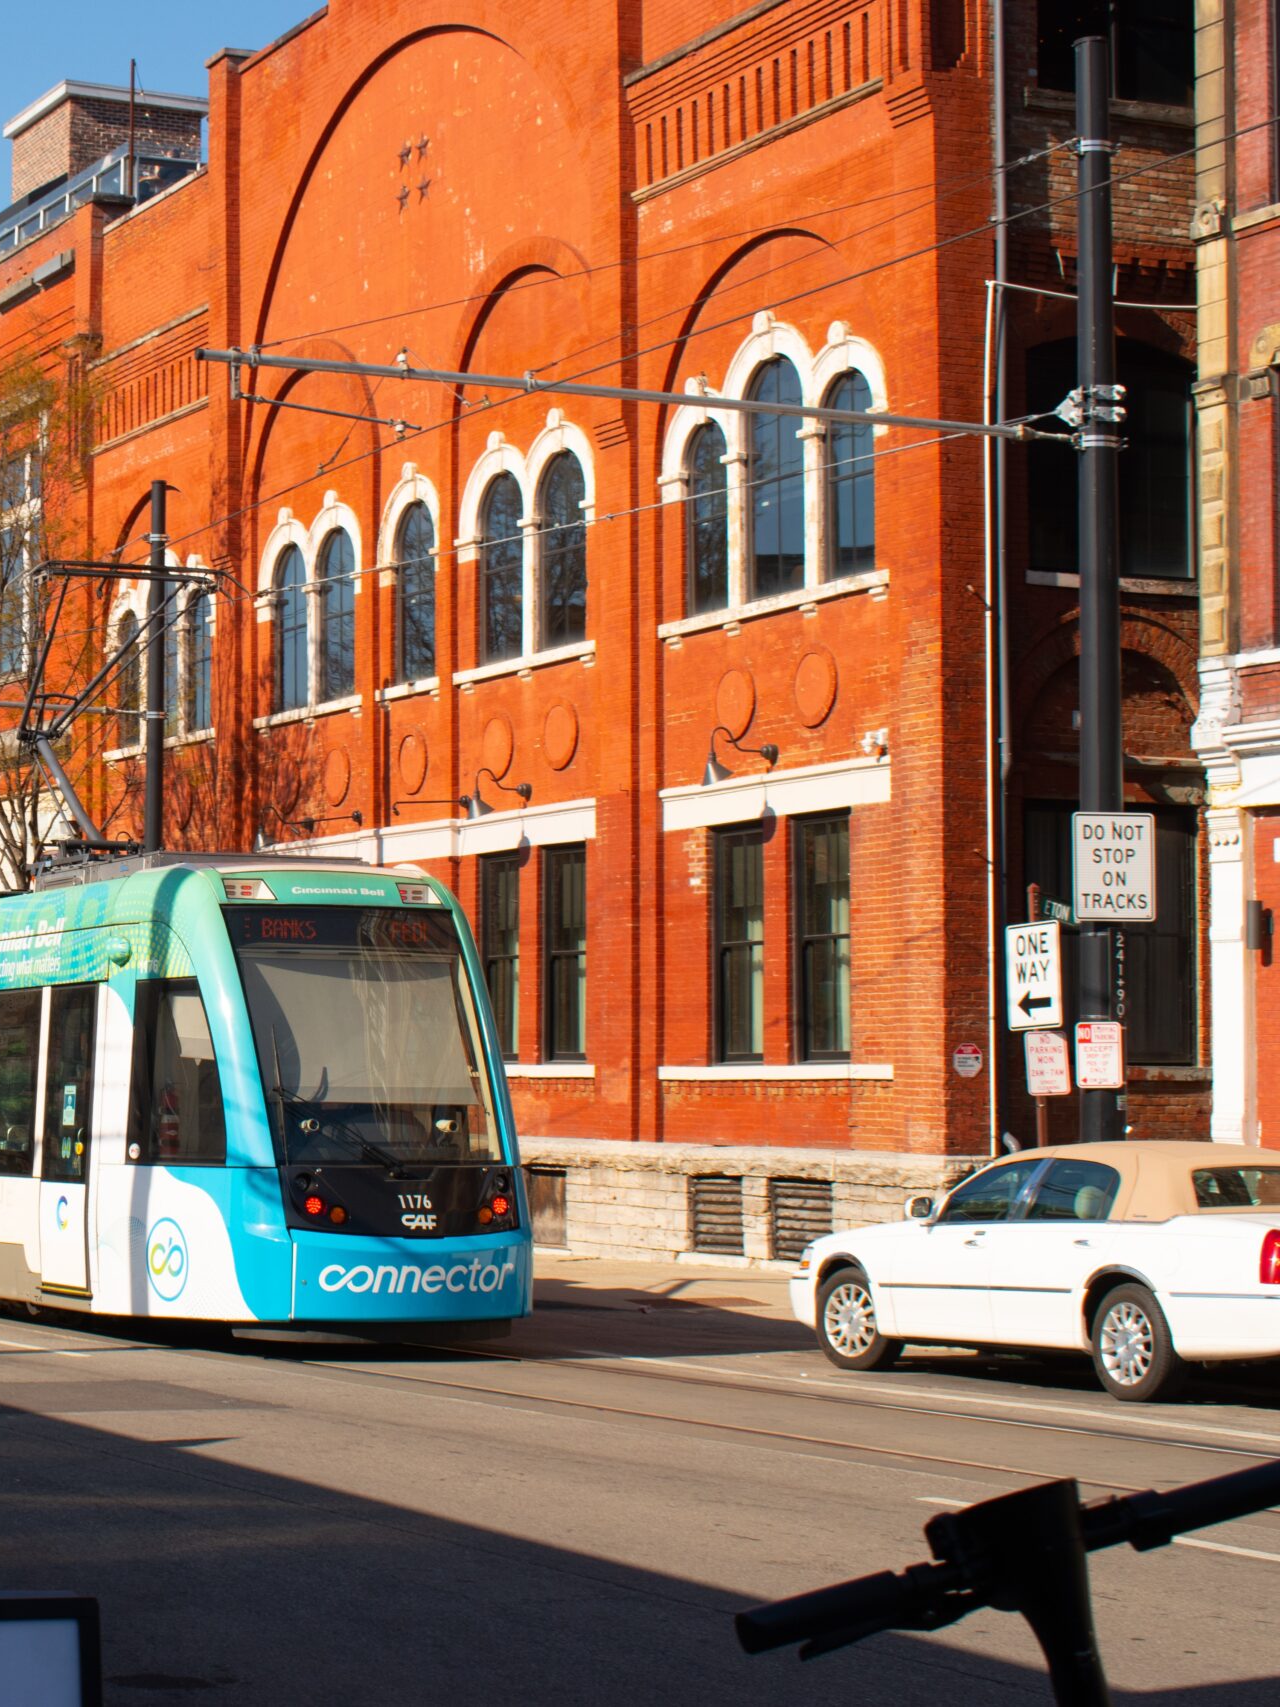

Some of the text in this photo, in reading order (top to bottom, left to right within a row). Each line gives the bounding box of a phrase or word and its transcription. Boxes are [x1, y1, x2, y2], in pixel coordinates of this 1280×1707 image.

[1084, 824, 1144, 840] DO NOT
[1092, 848, 1135, 864] STOP
[1103, 871, 1126, 886] ON
[291, 886, 385, 896] Cincinnati Bell
[1082, 893, 1147, 909] TRACKS
[35, 917, 65, 948] Bell
[261, 918, 317, 940] BANKS
[1016, 932, 1048, 956] ONE
[1016, 959, 1050, 984] WAY
[1040, 1036, 1051, 1044] NO
[1078, 1028, 1090, 1039] NO
[398, 1195, 432, 1209] 1176
[401, 1214, 437, 1230] CAF
[318, 1258, 514, 1293] connector
